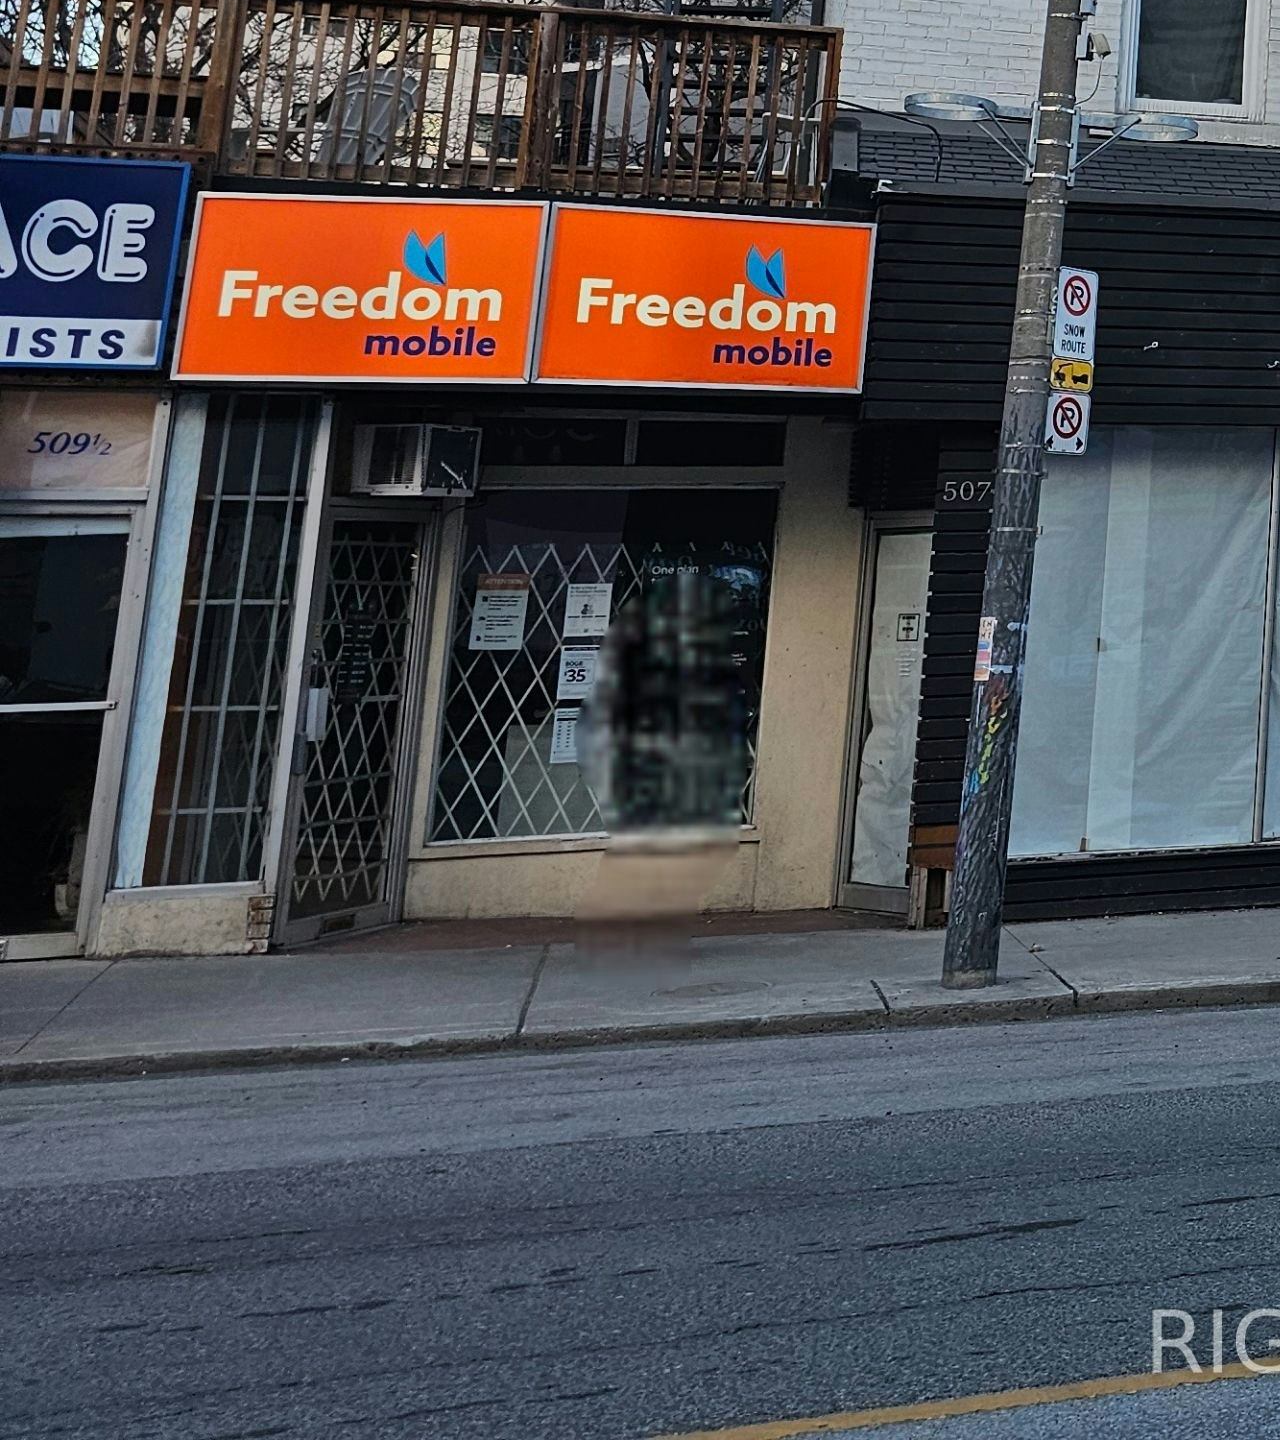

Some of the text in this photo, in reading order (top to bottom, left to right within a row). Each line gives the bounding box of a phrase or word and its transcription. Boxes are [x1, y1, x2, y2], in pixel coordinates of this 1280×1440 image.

[0, 199, 155, 282] CE
[218, 270, 502, 322] Freedom
[576, 277, 836, 334] Freedom
[6, 327, 125, 359] ISTS
[364, 326, 496, 357] mobile
[1063, 324, 1085, 338] SNOW
[713, 337, 832, 367] mobile
[1061, 340, 1086, 354] ROUTE
[943, 481, 991, 502] 507
[651, 565, 675, 575] One
